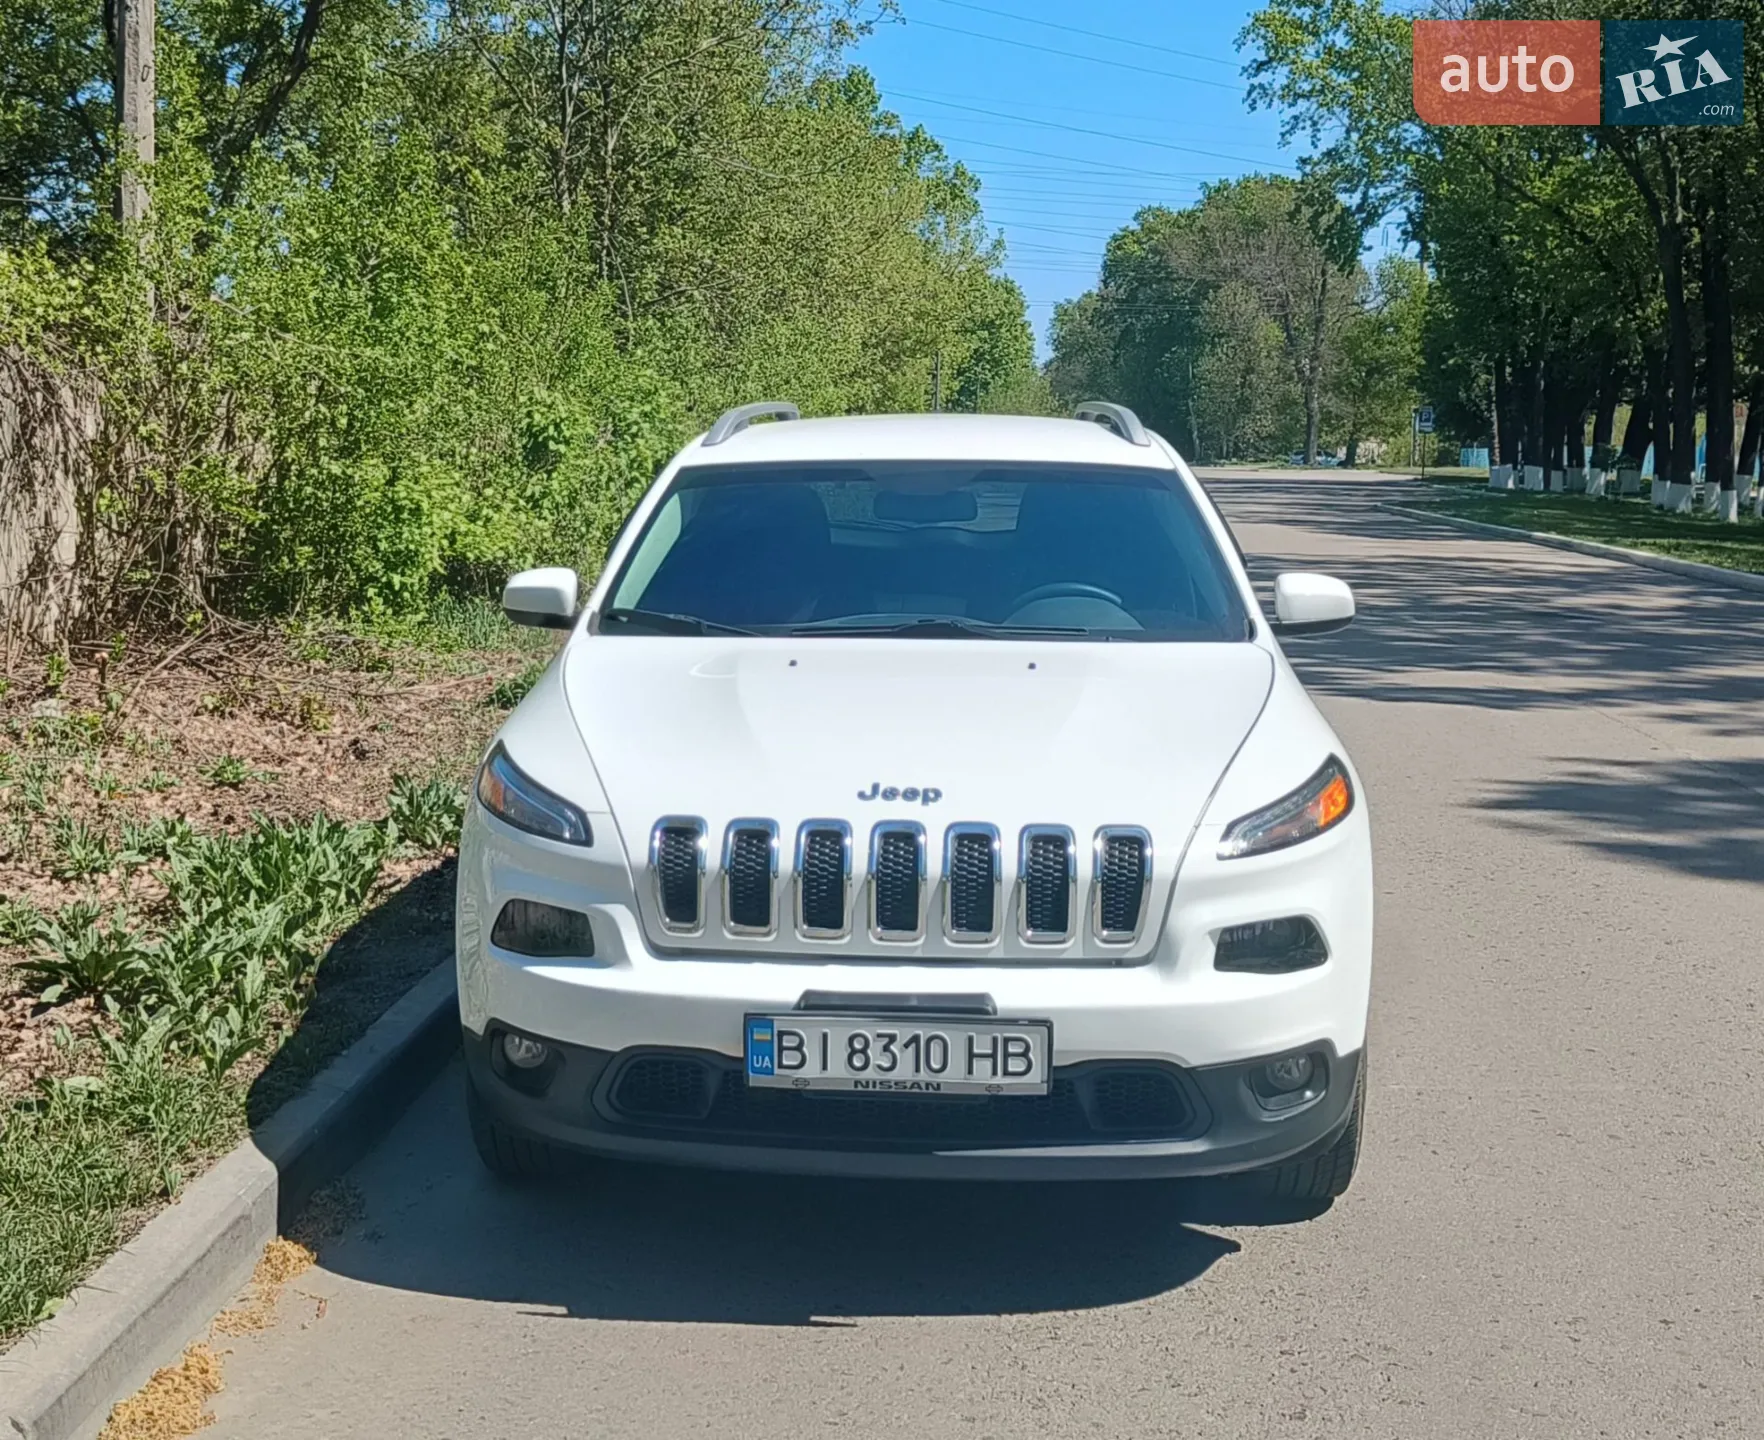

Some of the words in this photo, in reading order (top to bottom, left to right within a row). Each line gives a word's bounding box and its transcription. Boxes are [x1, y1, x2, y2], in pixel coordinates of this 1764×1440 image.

[857, 782, 943, 806] Jeep
[753, 1055, 772, 1068] UA
[847, 1032, 949, 1074] 8310
[967, 1034, 1034, 1077] HB
[853, 1080, 942, 1092] NISSAN
